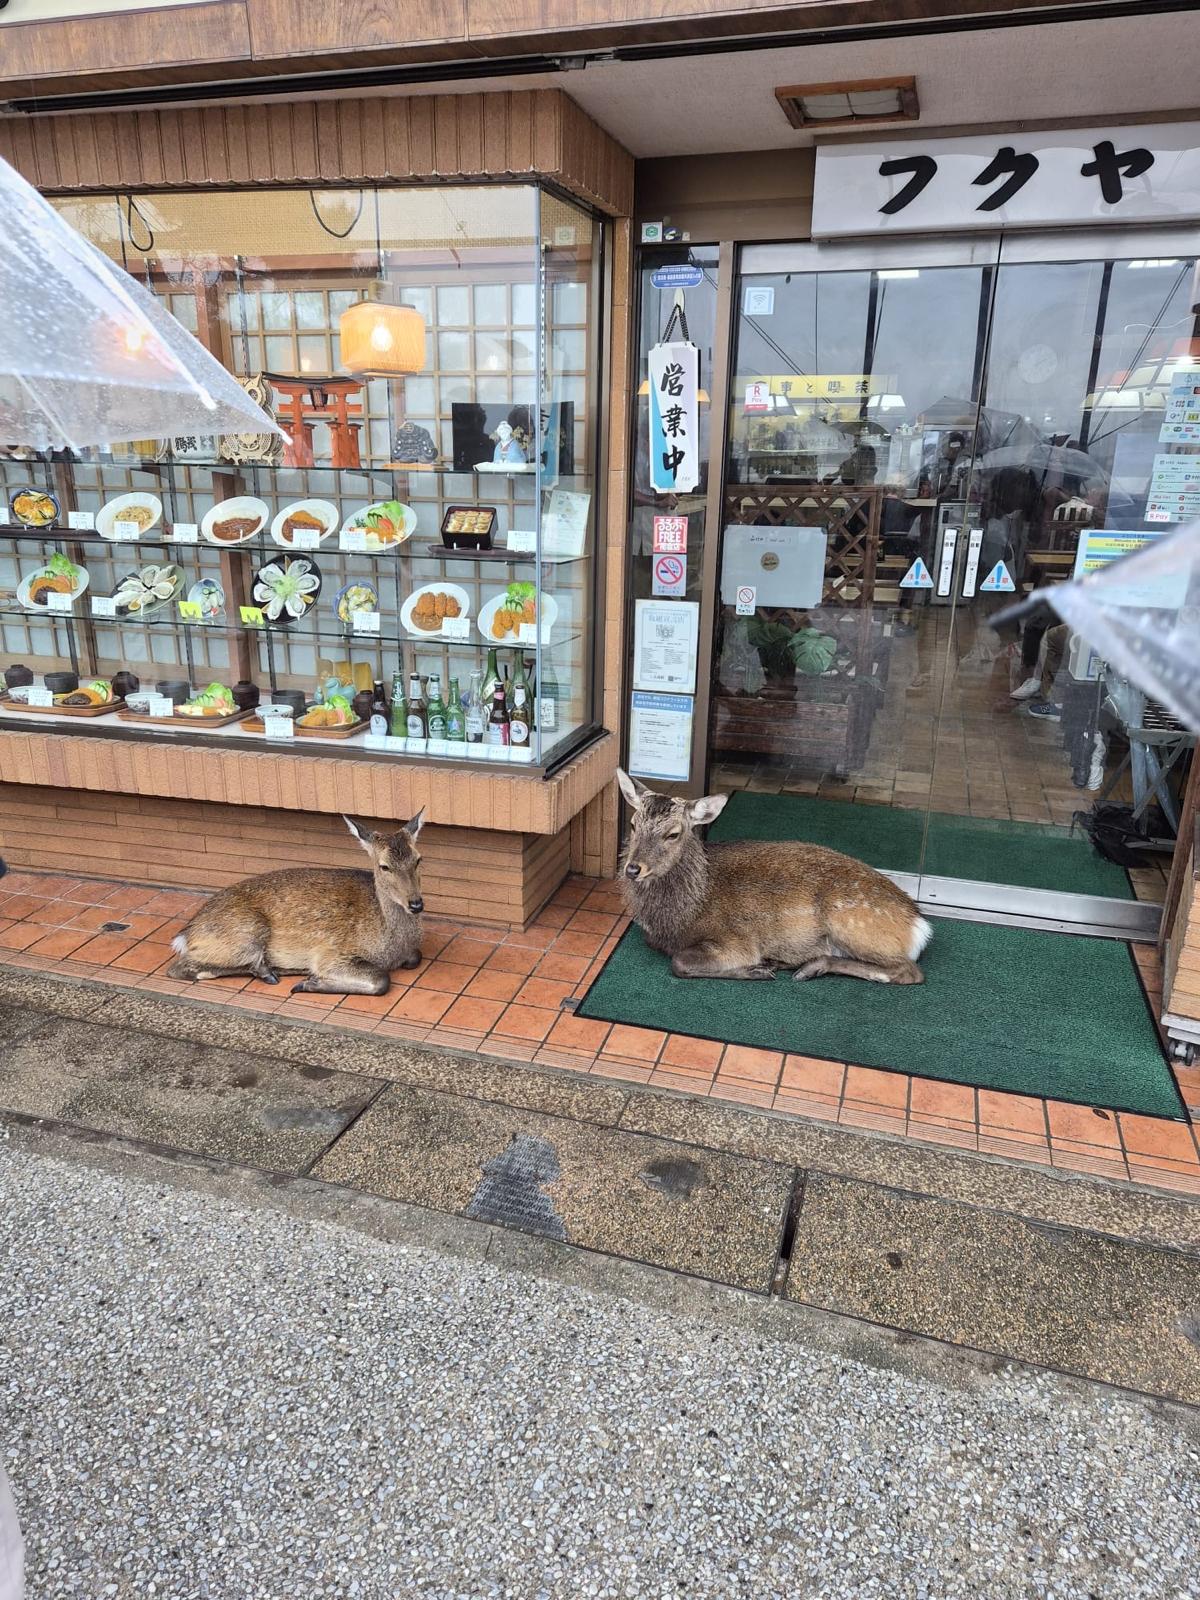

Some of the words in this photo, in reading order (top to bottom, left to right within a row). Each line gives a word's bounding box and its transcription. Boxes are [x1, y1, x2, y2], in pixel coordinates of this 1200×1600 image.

[878, 141, 1155, 215] フクヤ
[755, 380, 870, 394] 事と喫茶
[660, 363, 687, 482] 営業中
[659, 531, 682, 543] FREE
